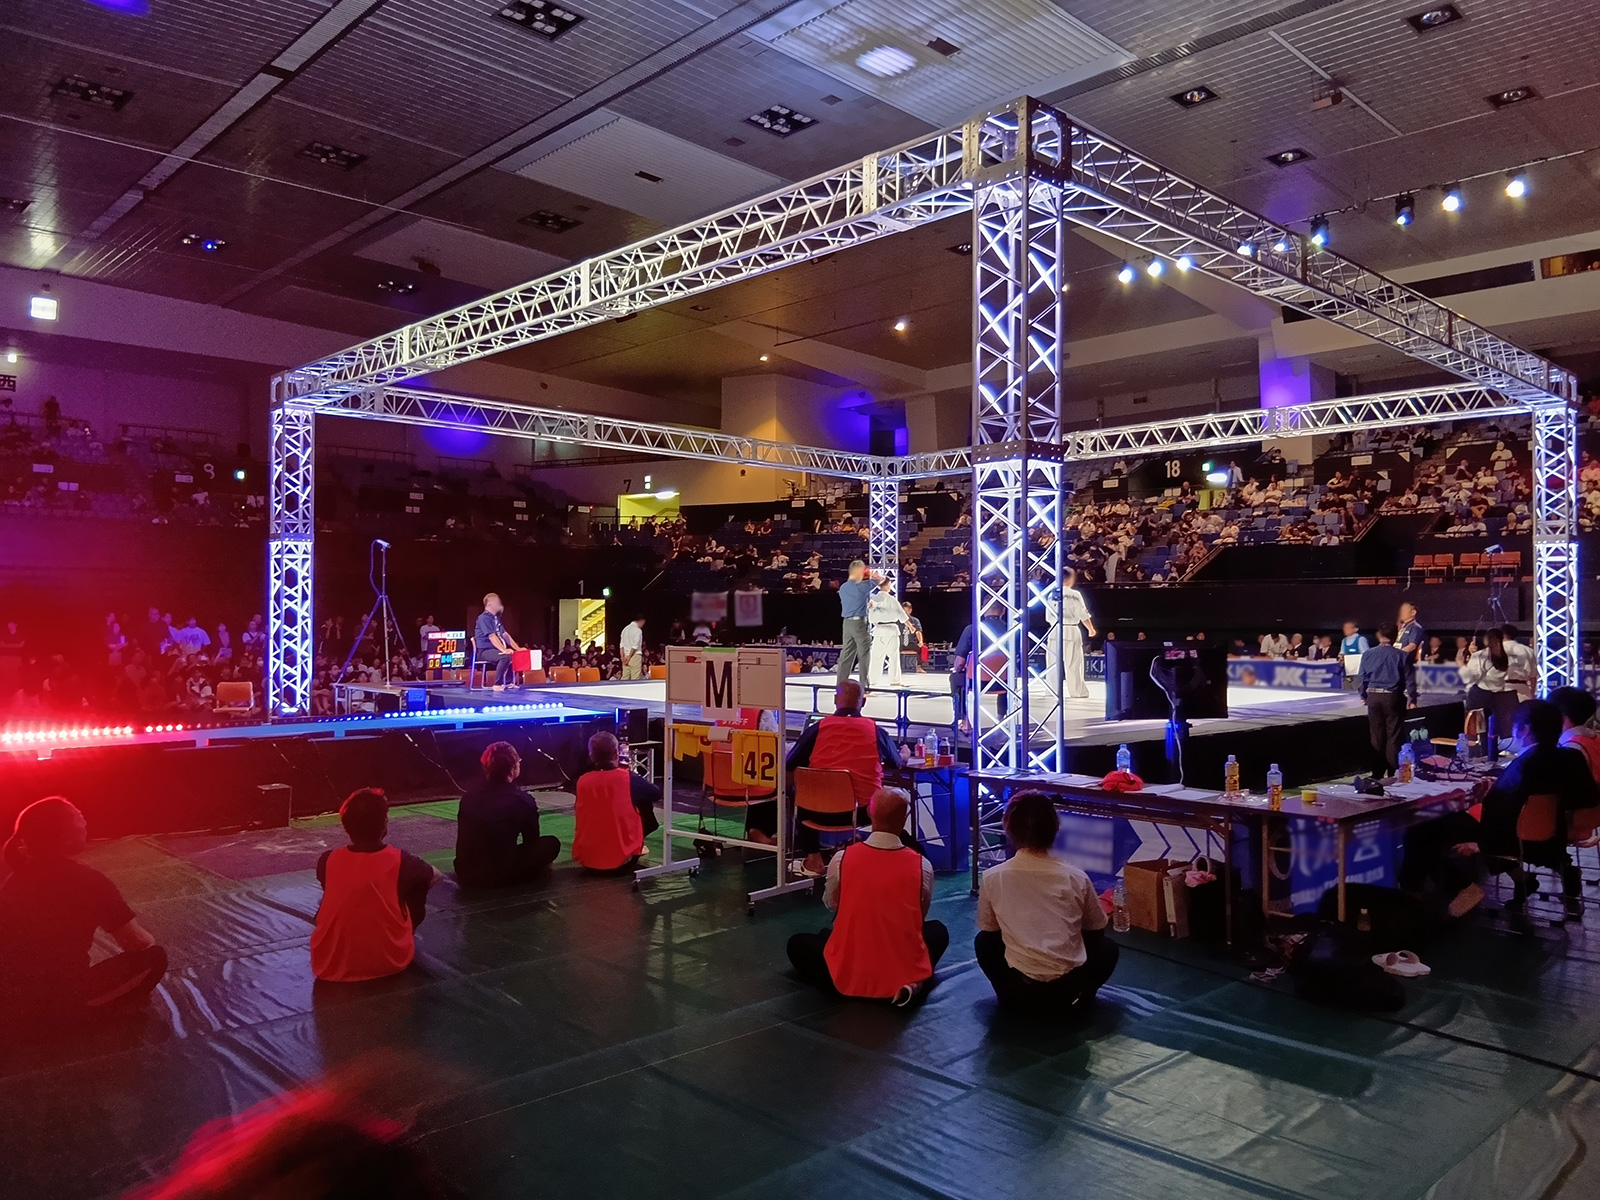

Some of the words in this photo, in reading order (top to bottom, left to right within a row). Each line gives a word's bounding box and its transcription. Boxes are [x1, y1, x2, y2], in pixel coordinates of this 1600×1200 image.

[1165, 460, 1180, 478] 18
[623, 479, 632, 493] 7
[578, 580, 584, 595] 1
[437, 639, 457, 653] 2:00
[705, 660, 733, 709] M
[744, 751, 776, 781] 42
